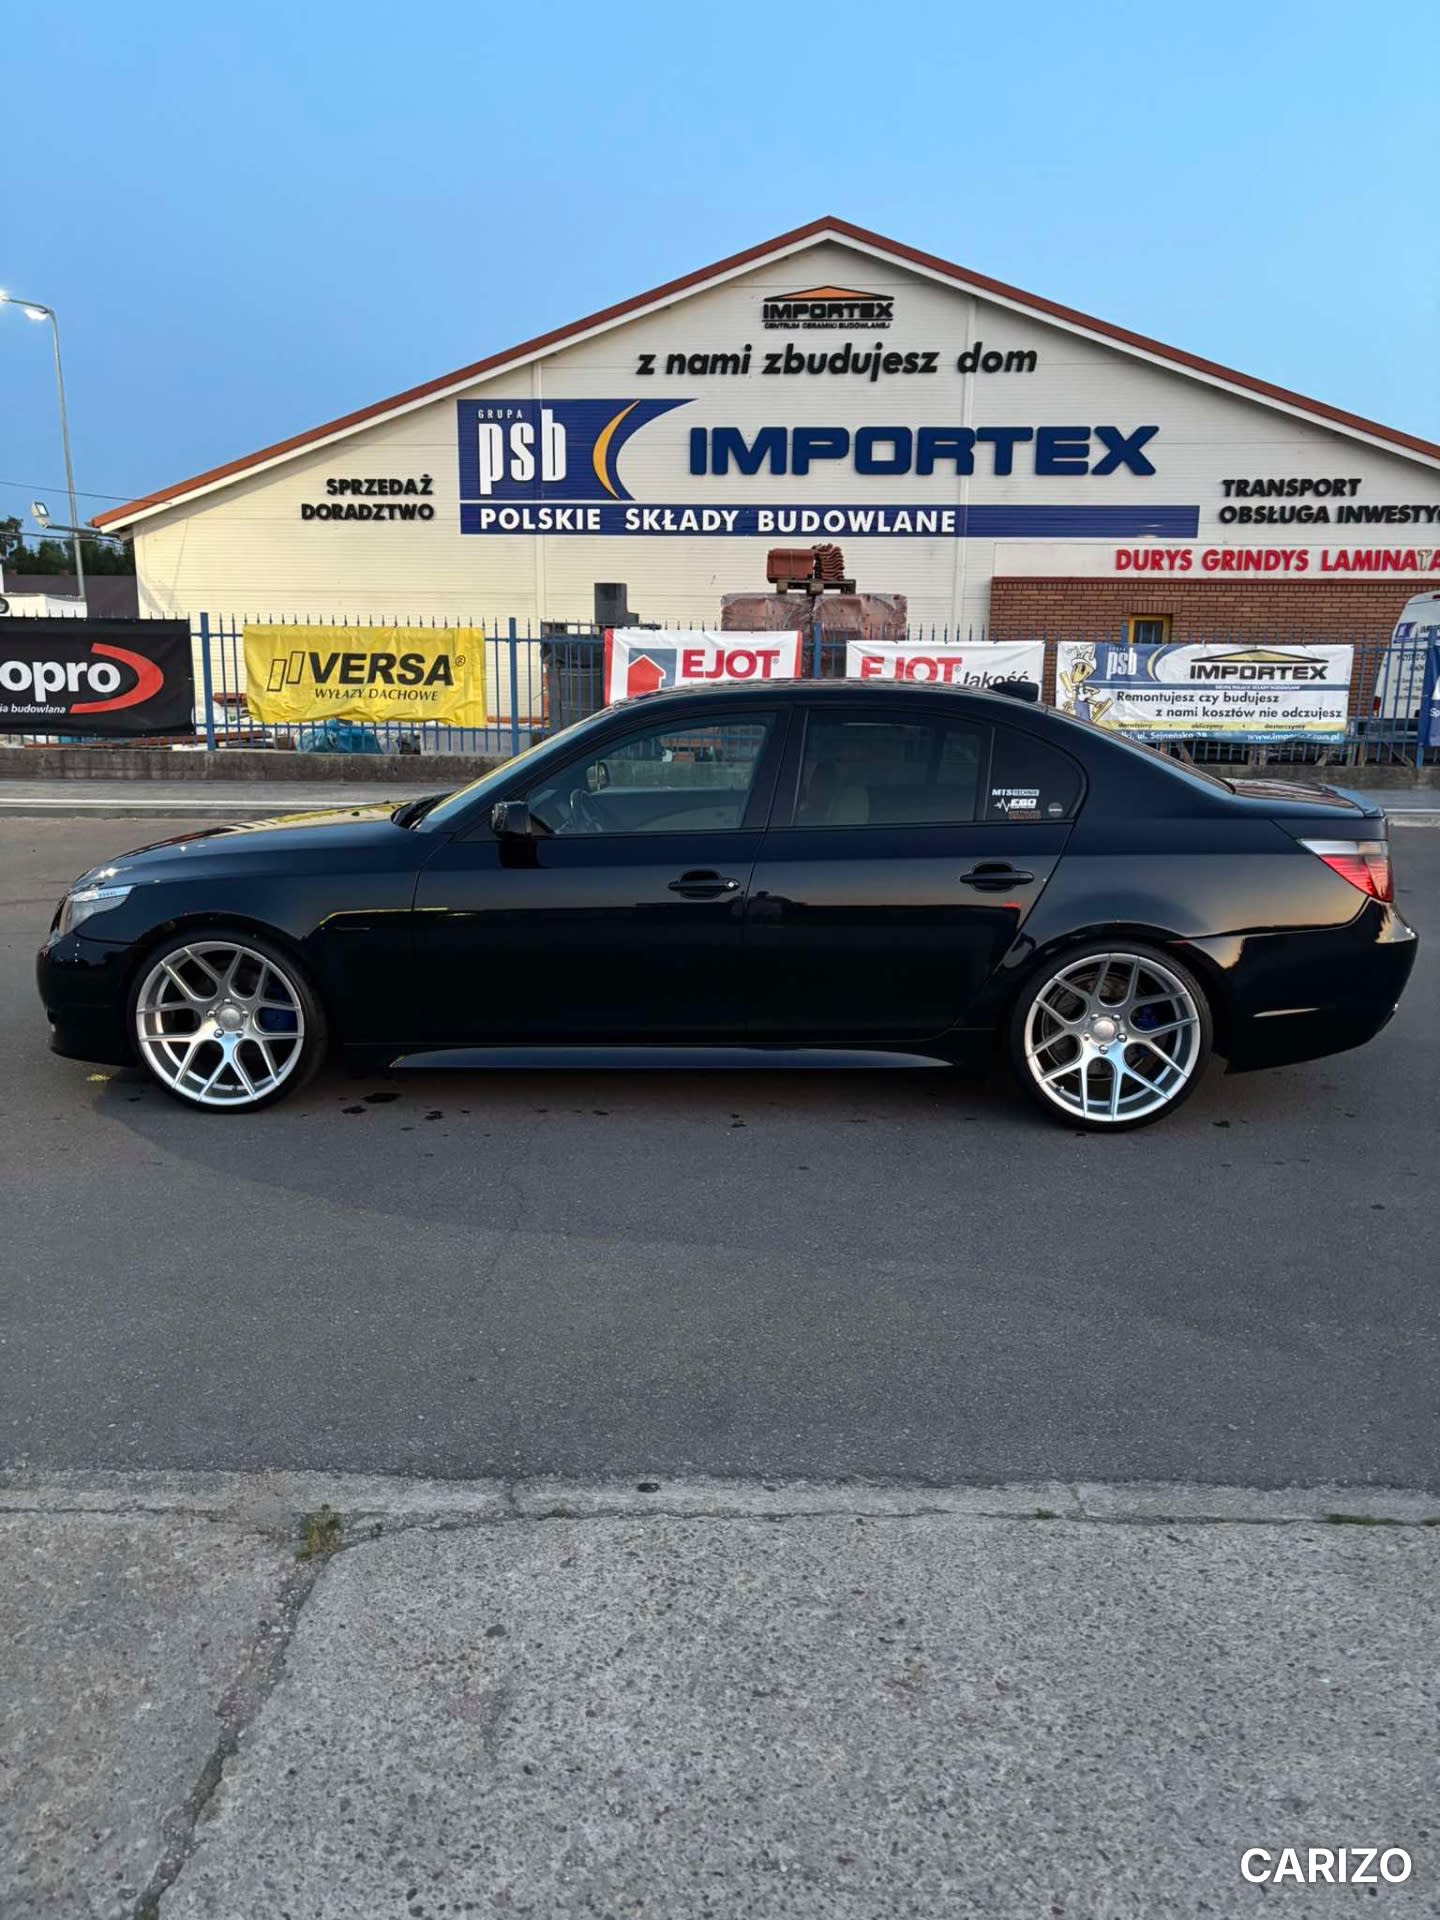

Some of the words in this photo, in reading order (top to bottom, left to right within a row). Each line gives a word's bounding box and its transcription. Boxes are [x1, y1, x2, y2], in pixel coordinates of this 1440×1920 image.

[762, 302, 894, 319] IMPORTEX
[635, 353, 656, 376] z
[665, 343, 752, 375] nami
[762, 342, 940, 383] zbudujesz
[957, 341, 1038, 374] dom
[478, 409, 523, 419] GRUPA
[478, 409, 567, 495] psb
[689, 425, 1160, 476] IMPORTEX
[326, 473, 433, 496] SPRZEDAŻ
[1221, 478, 1362, 497] TRANSPORT
[301, 503, 435, 521] DORADZTWO
[480, 508, 601, 531] POLSKIE
[625, 508, 738, 532] SKŁADY
[758, 509, 957, 533] BUDOWLANE
[1218, 505, 1331, 524] OBSŁUGA
[1337, 505, 1440, 524] INWESTY
[1115, 549, 1193, 572] DURYS
[1201, 549, 1309, 572] GRINDYS
[309, 652, 454, 686] VERSA
[682, 649, 780, 679] EJOT
[1106, 647, 1137, 680] psb
[1189, 664, 1328, 681] IMPORTEX
[314, 687, 365, 699] WYŁAZY
[368, 688, 438, 701] DACHOWE
[1116, 690, 1195, 705] Remontujesz
[1198, 694, 1219, 705] czy
[1223, 691, 1280, 706] budujesz
[11, 703, 66, 714] budowlana
[1155, 709, 1162, 717] z
[1166, 706, 1198, 718] nami
[1202, 706, 1256, 718] kosztów
[1259, 707, 1278, 718] nie
[1282, 706, 1343, 720] odczujesz
